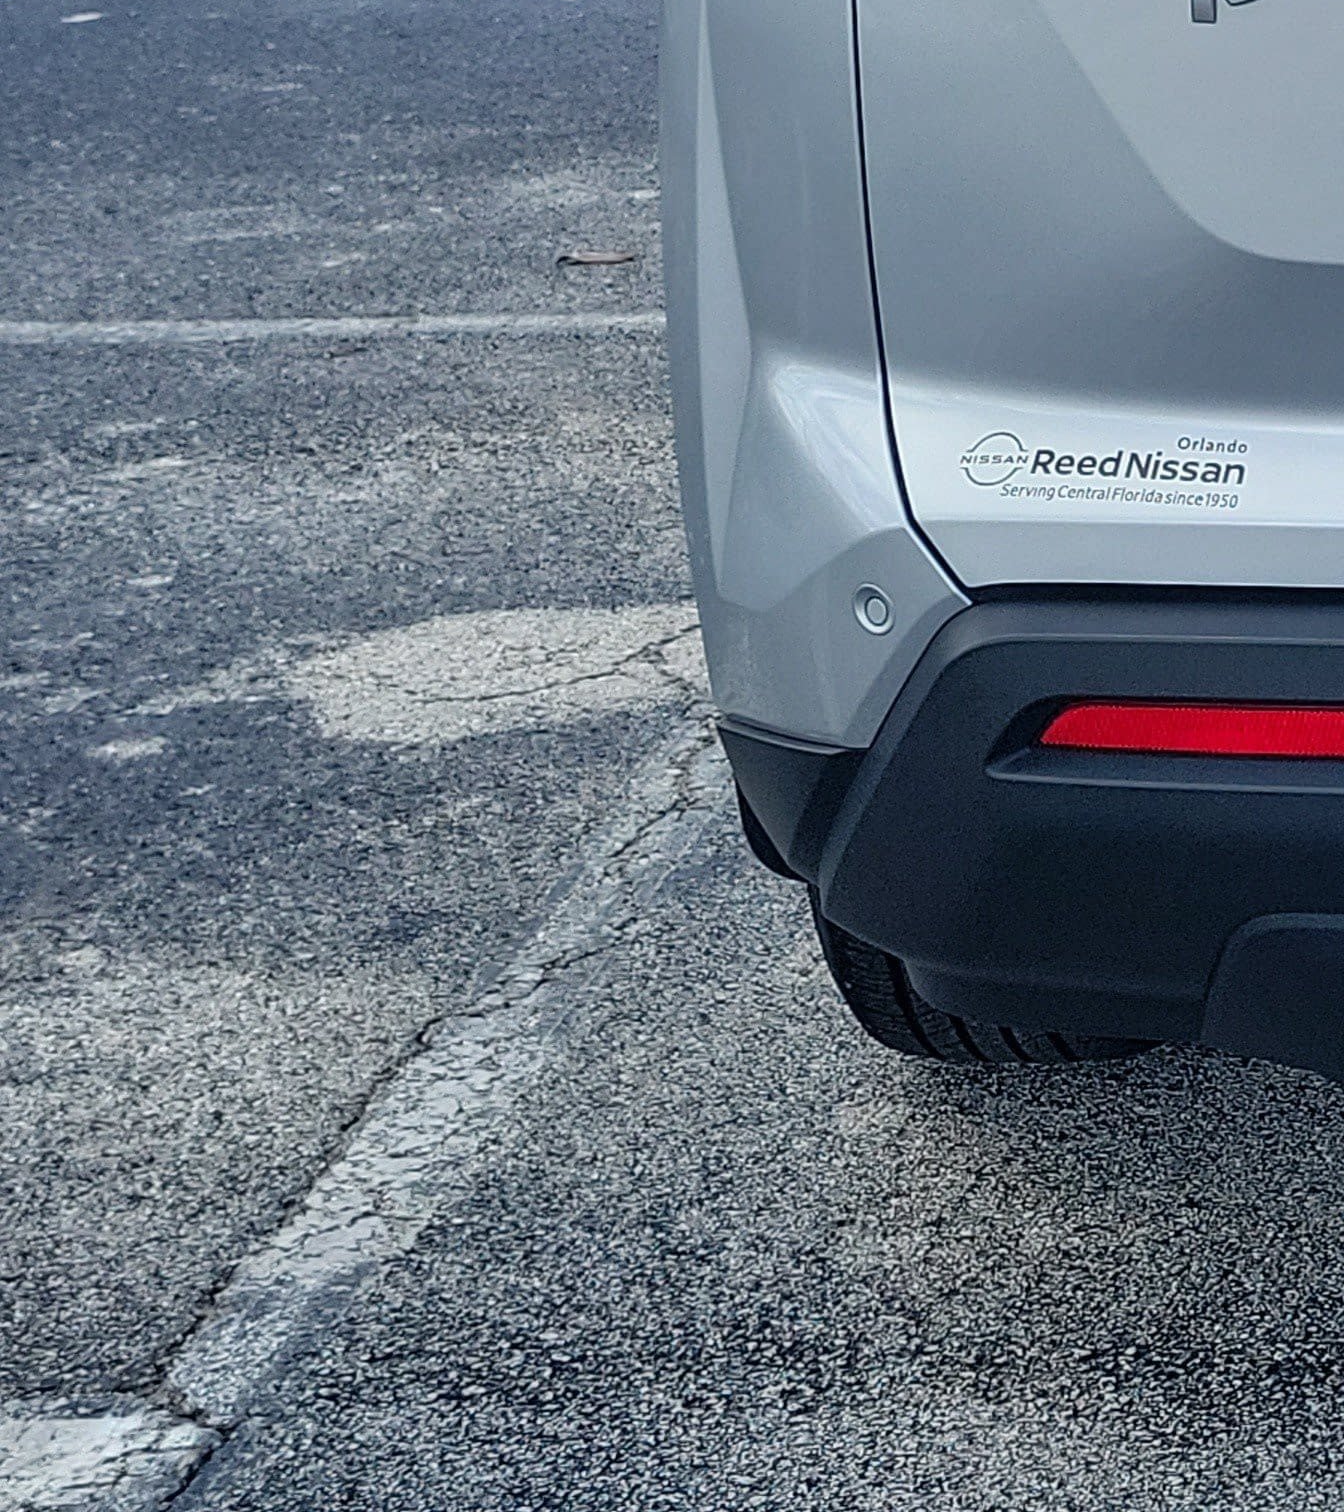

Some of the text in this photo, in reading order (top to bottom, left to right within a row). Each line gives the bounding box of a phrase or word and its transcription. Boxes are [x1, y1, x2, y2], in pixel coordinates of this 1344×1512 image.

[1177, 437, 1248, 454] Orlando
[960, 454, 1029, 465] NISSAN
[1030, 450, 1245, 485] Reed Nissan
[999, 483, 1239, 508] Serving Central Florida since 1950
